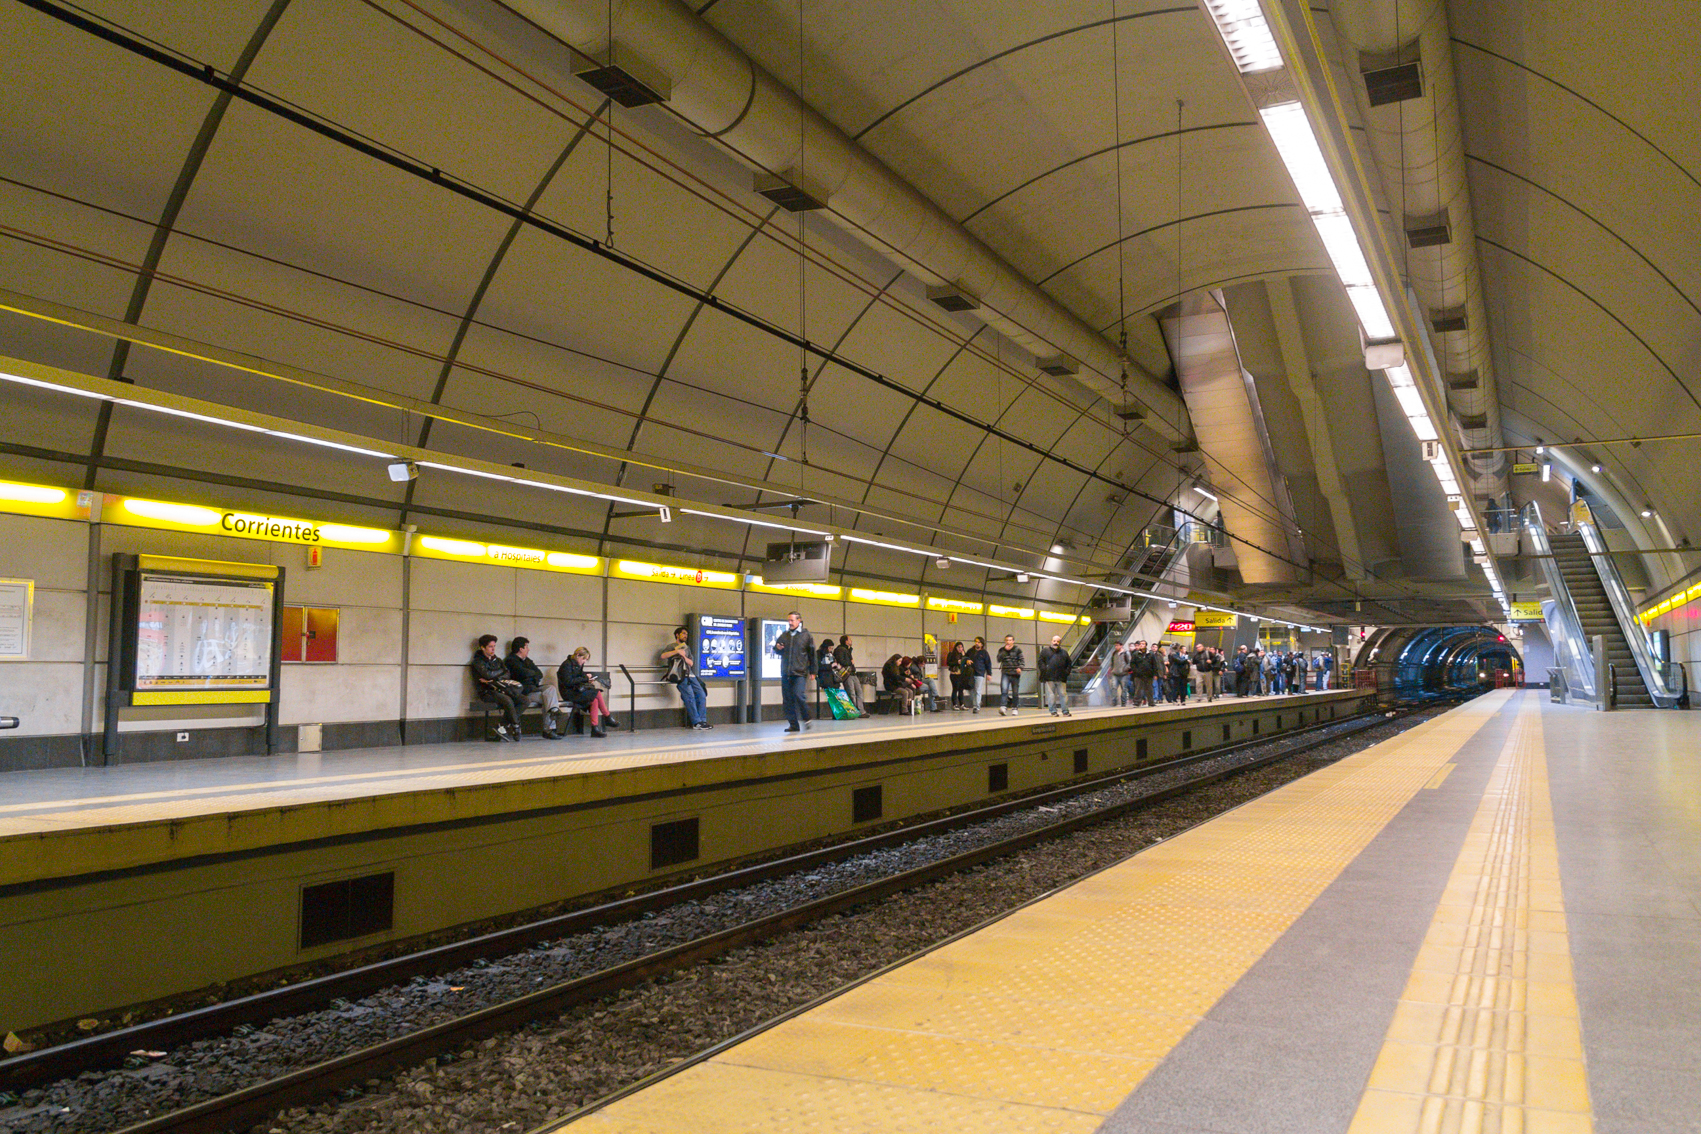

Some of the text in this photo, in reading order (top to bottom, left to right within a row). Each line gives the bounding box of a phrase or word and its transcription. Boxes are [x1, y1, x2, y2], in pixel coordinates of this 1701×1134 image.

[221, 513, 320, 541] Corrientes
[501, 551, 541, 563] Hospitales
[651, 568, 670, 578] Salida
